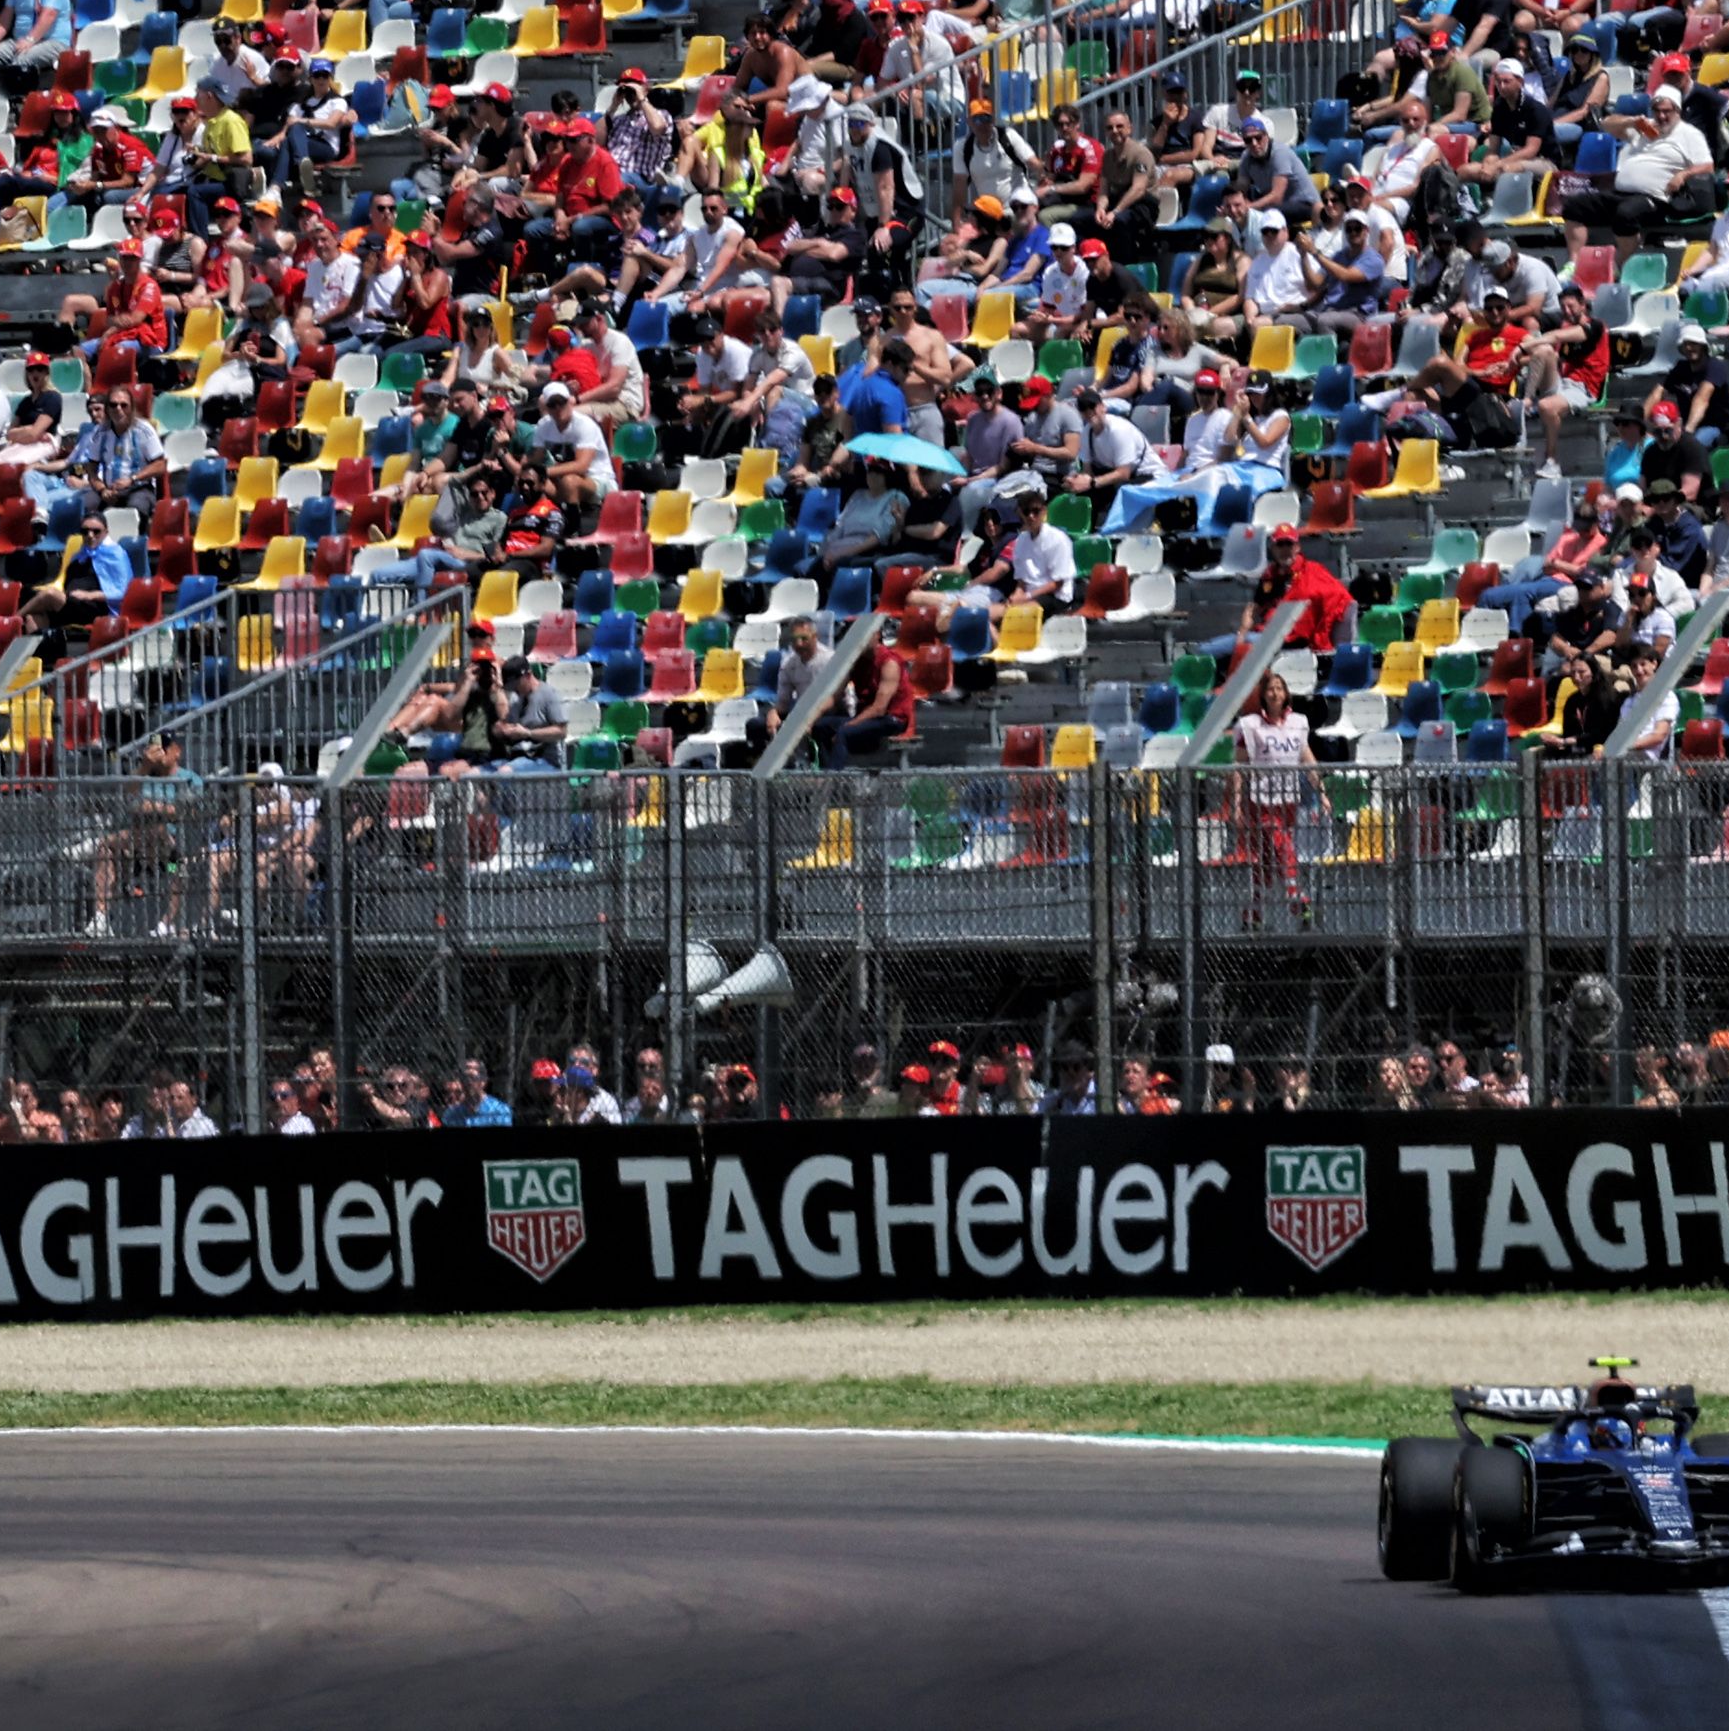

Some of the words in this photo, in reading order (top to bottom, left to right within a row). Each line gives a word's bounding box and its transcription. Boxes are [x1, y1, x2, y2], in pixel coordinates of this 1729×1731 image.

[493, 1169, 572, 1207] TAG
[1275, 1155, 1355, 1192] TAG
[494, 1219, 578, 1271] HEUER
[1273, 1204, 1360, 1260] HEUER
